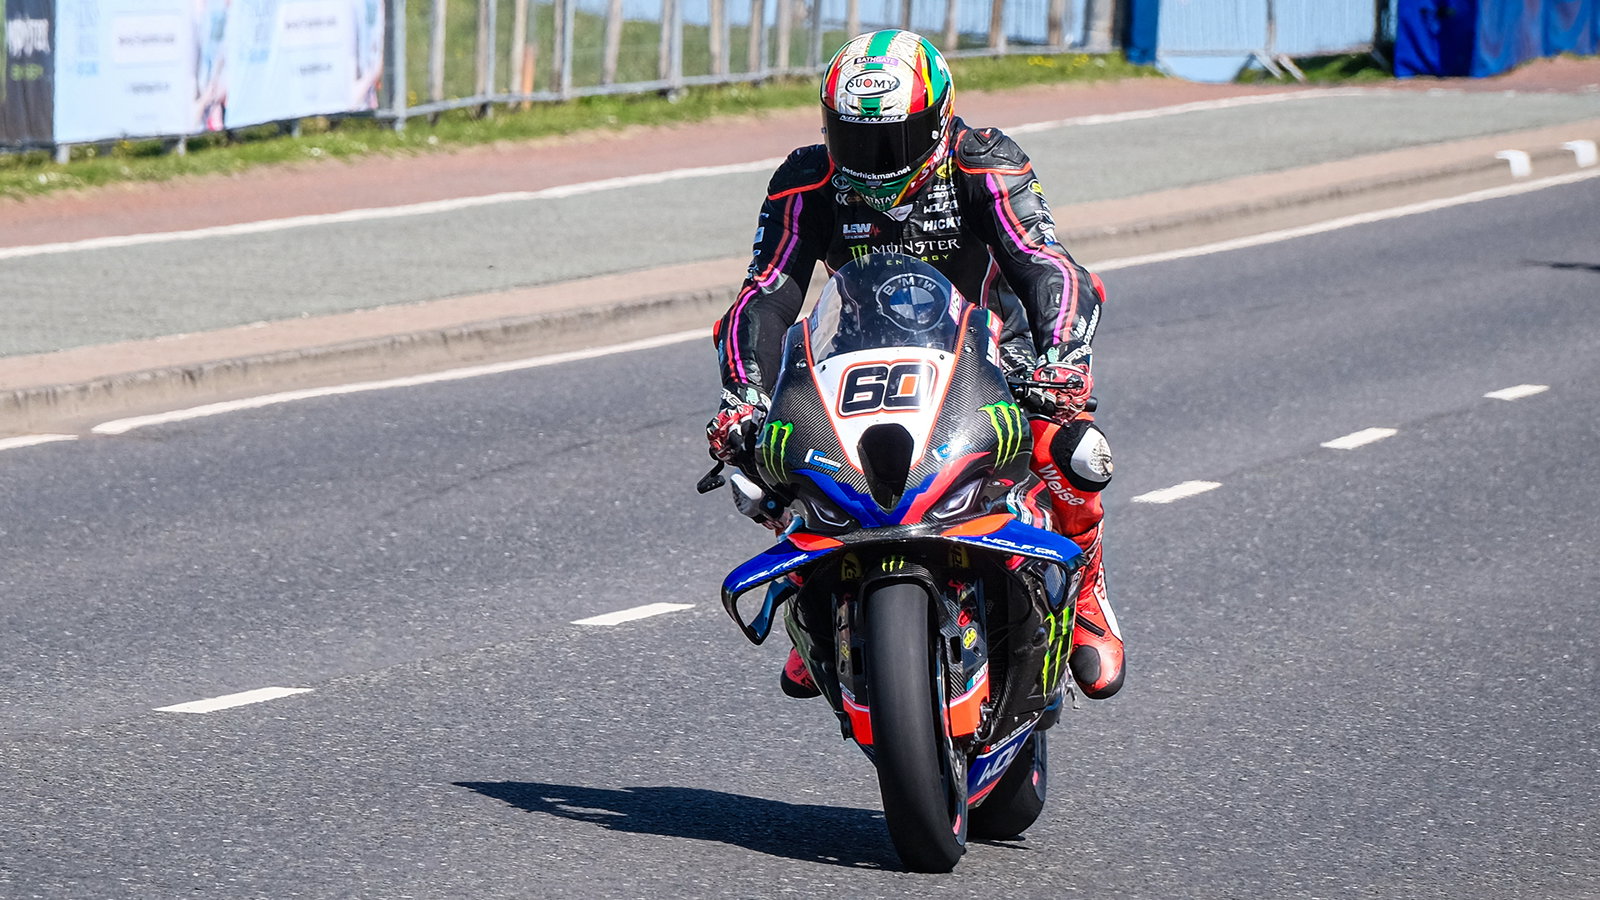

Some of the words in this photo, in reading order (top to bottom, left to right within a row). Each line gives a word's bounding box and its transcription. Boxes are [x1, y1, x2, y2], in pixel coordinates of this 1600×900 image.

[855, 56, 897, 66] BATHGATE
[848, 78, 896, 90] SUOMY
[840, 113, 882, 122] NOLAN
[841, 165, 911, 180] peterhickman.net
[842, 223, 872, 234] LEW
[922, 216, 962, 232] HICKY
[872, 239, 961, 258] MONSTER
[886, 254, 949, 266] ENERGY
[882, 276, 936, 297] BMW
[842, 363, 935, 415] 60
[1039, 463, 1086, 506] Weise
